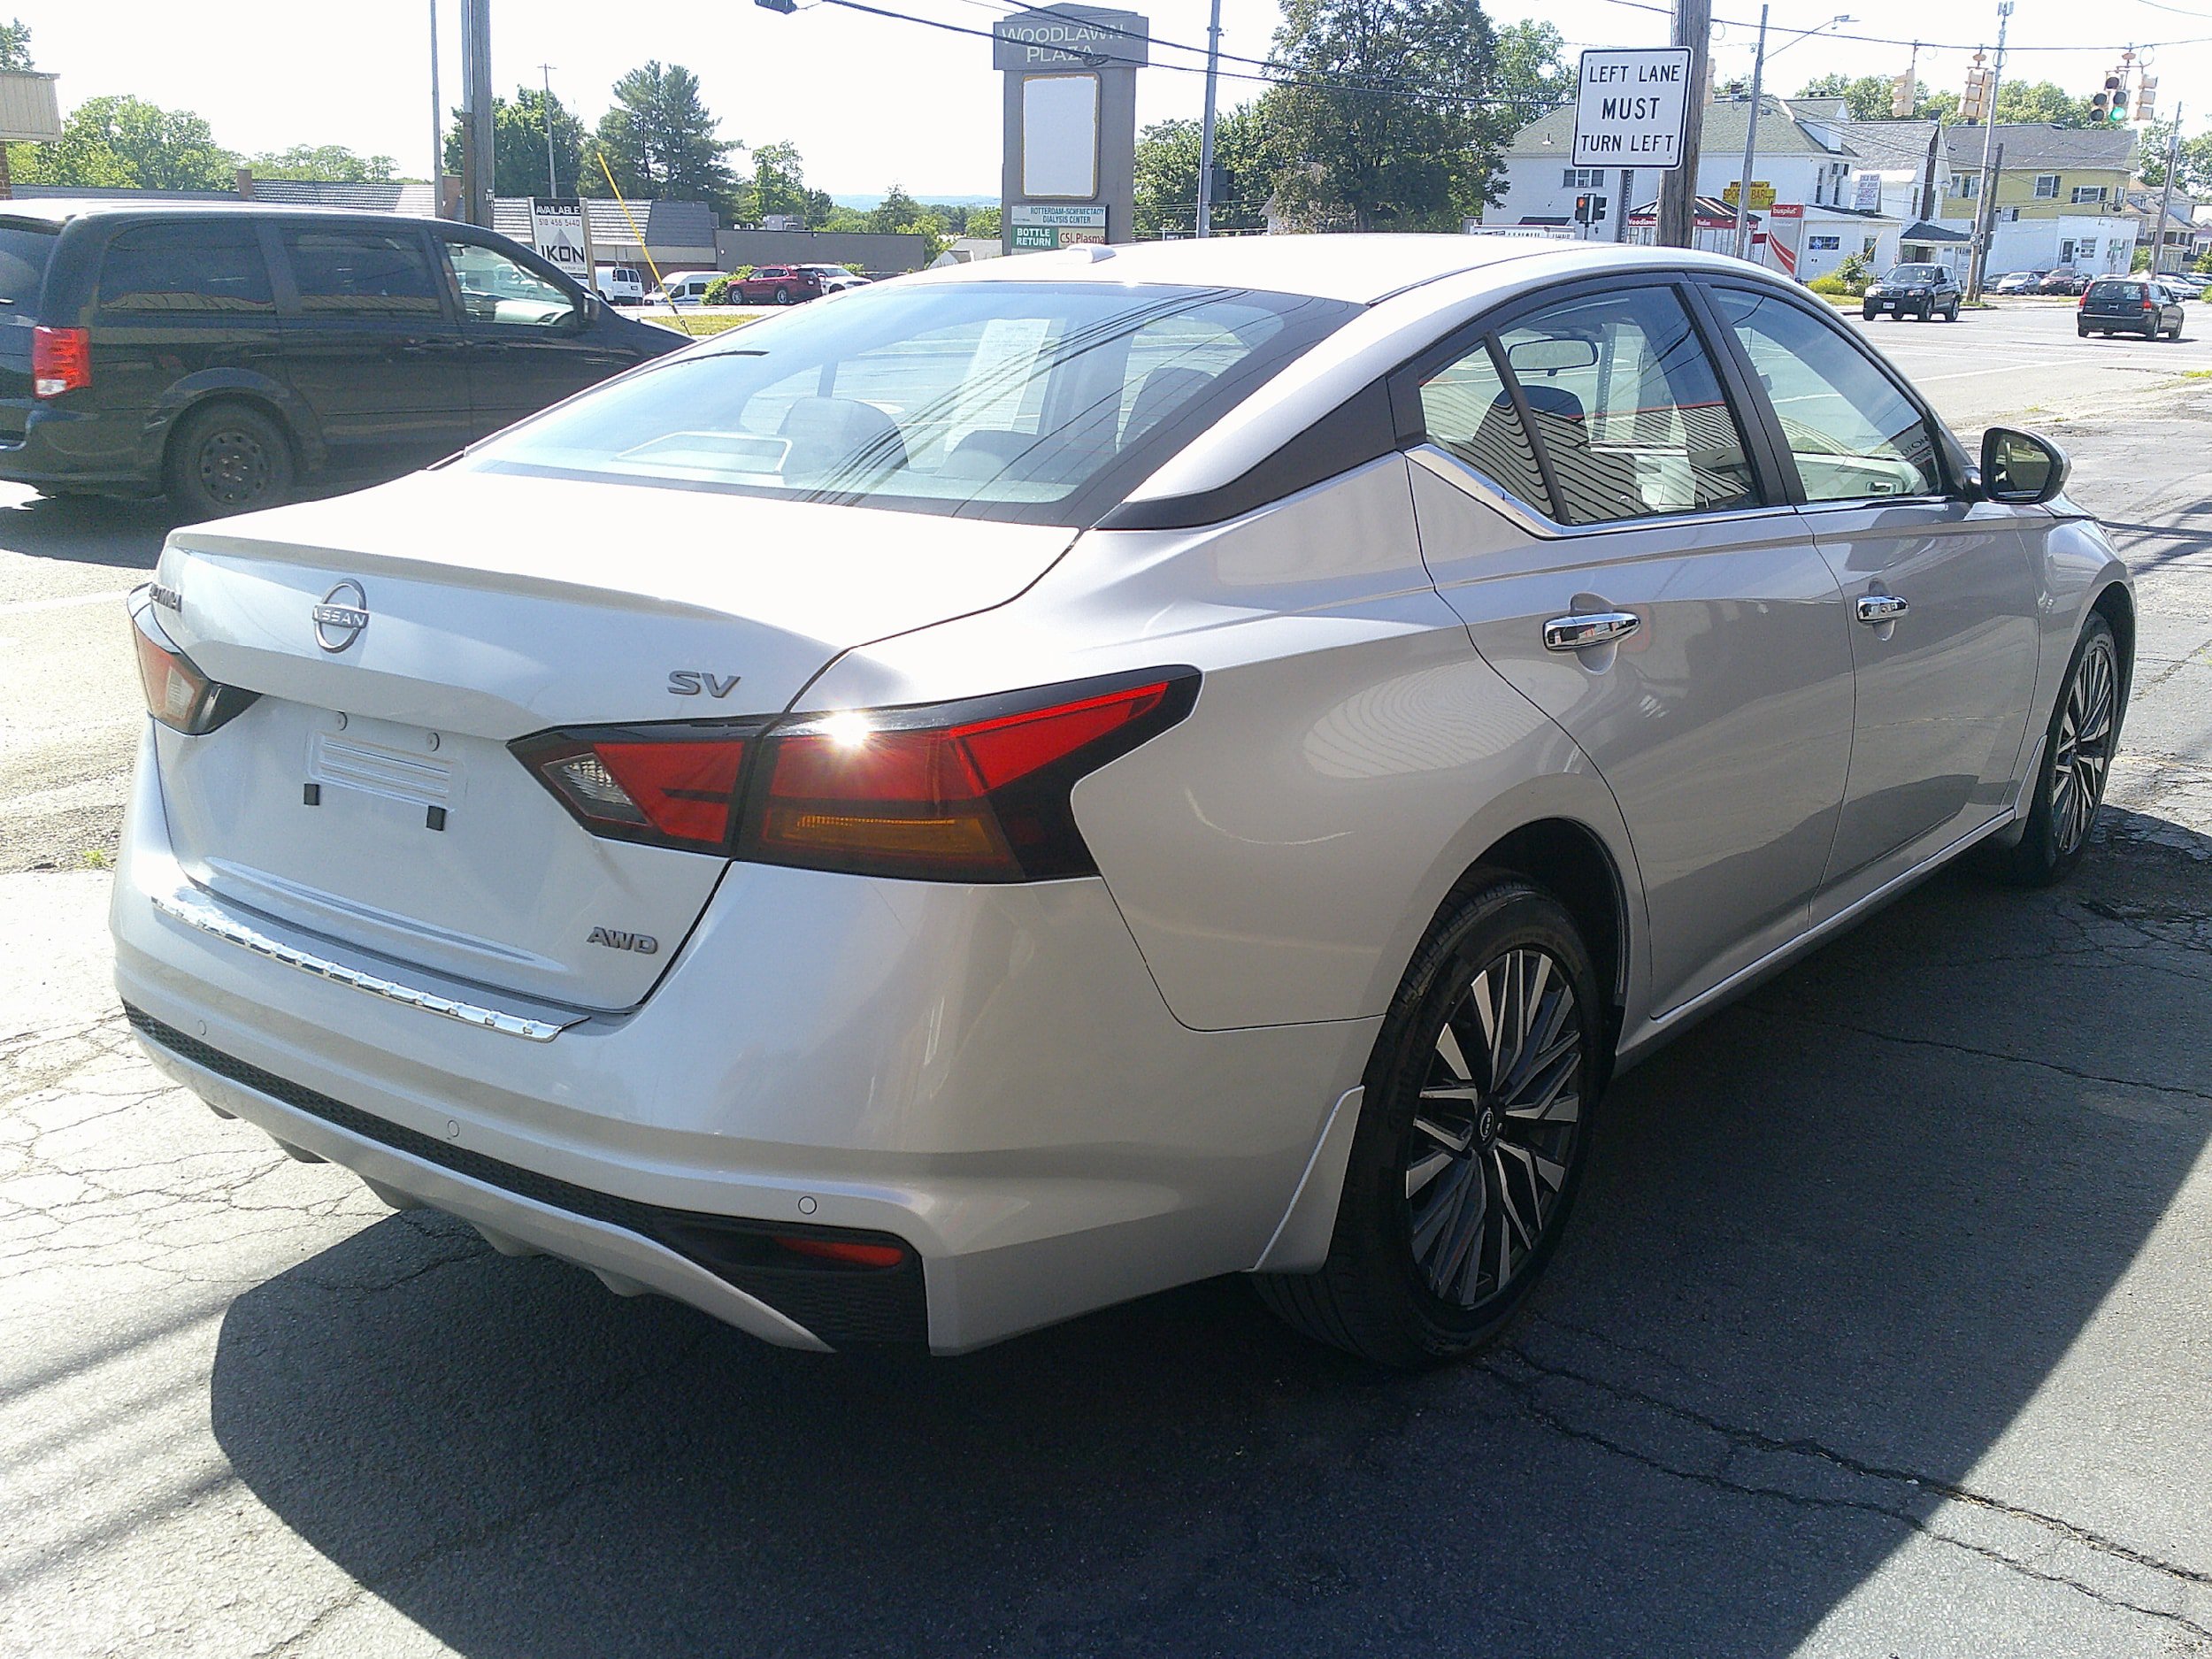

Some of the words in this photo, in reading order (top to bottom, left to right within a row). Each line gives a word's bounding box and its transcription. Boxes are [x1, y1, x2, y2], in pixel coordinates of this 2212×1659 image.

[1002, 23, 1125, 44] WOODLAWN
[1026, 44, 1094, 63] PLAZA
[1589, 65, 1629, 82] LEFT
[1639, 65, 1681, 82] LANE
[1601, 97, 1660, 119] MUST
[1581, 134, 1622, 151] TURN
[1631, 134, 1674, 151] LEFT
[536, 205, 580, 215] AVAILABLE
[1042, 215, 1068, 224] DIALYSIS
[1017, 227, 1051, 237] BOTTLE
[1059, 232, 1075, 243] CSL
[1076, 233, 1105, 244] Plasma
[1016, 236, 1052, 247] RETURN
[541, 244, 586, 263] IKON
[312, 607, 367, 627] ISSAN
[667, 670, 741, 699] SV
[586, 926, 658, 955] AWD
